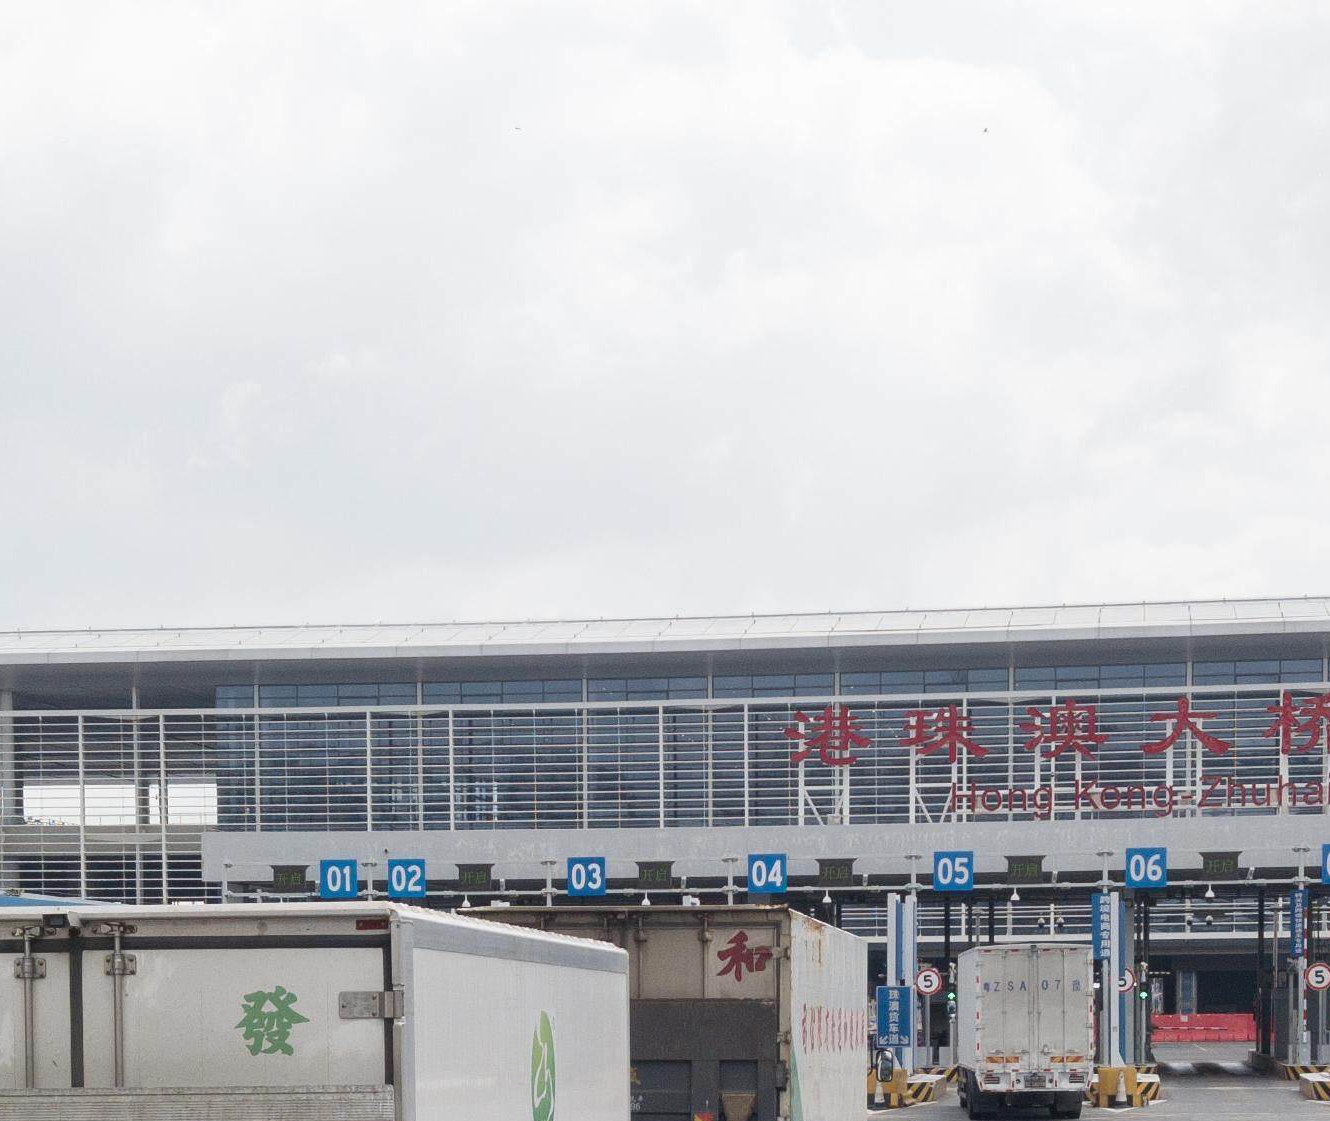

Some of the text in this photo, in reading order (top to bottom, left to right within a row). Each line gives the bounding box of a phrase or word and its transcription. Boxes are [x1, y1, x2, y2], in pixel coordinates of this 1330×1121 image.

[951, 781, 1053, 821] Hong
[327, 865, 351, 892] 01
[391, 865, 422, 892] 02
[571, 863, 602, 889] 03
[752, 860, 783, 886] 04
[937, 858, 969, 884] 05
[1130, 854, 1162, 881] 06
[717, 931, 773, 982] 和
[923, 974, 933, 988] 5
[1315, 970, 1325, 984] 5
[235, 985, 310, 1056] 發
